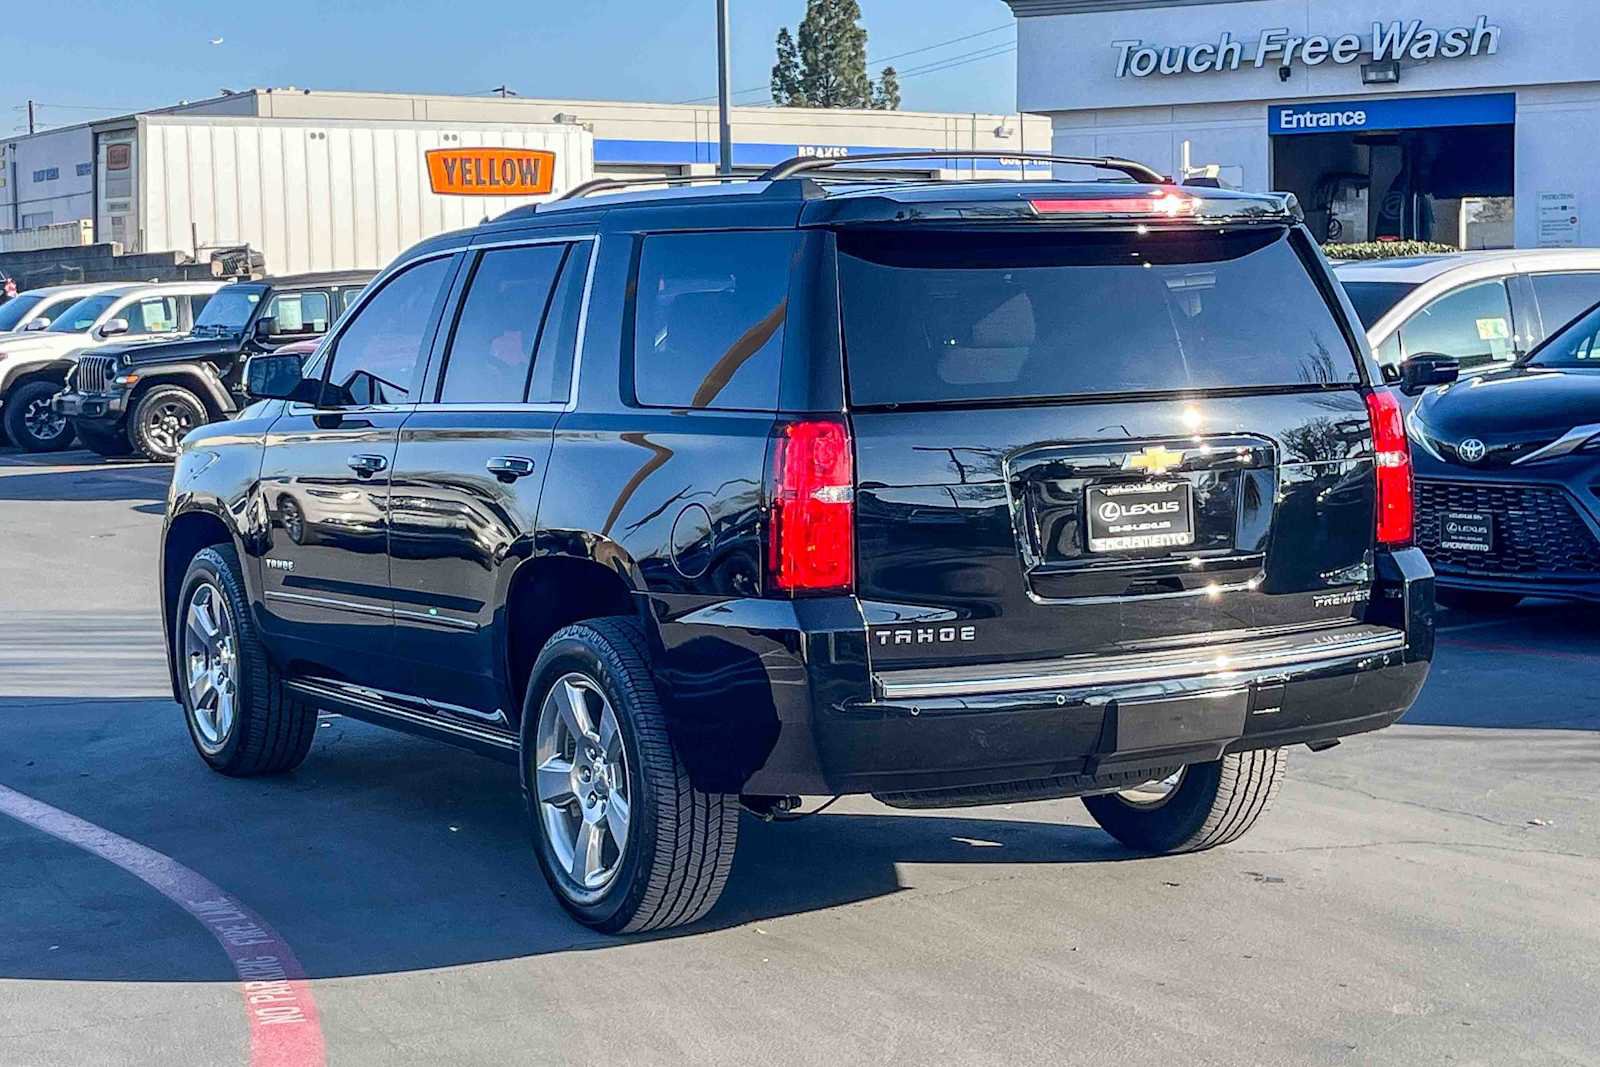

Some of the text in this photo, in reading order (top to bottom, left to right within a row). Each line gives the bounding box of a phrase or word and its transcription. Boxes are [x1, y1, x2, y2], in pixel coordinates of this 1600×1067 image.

[1111, 16, 1500, 78] Touch Free Wash
[1281, 108, 1366, 128] Entrance
[442, 157, 541, 186] YELLOW
[1121, 501, 1180, 516] LEXUS
[876, 626, 975, 645] TAHOE
[255, 1006, 307, 1026] NO
